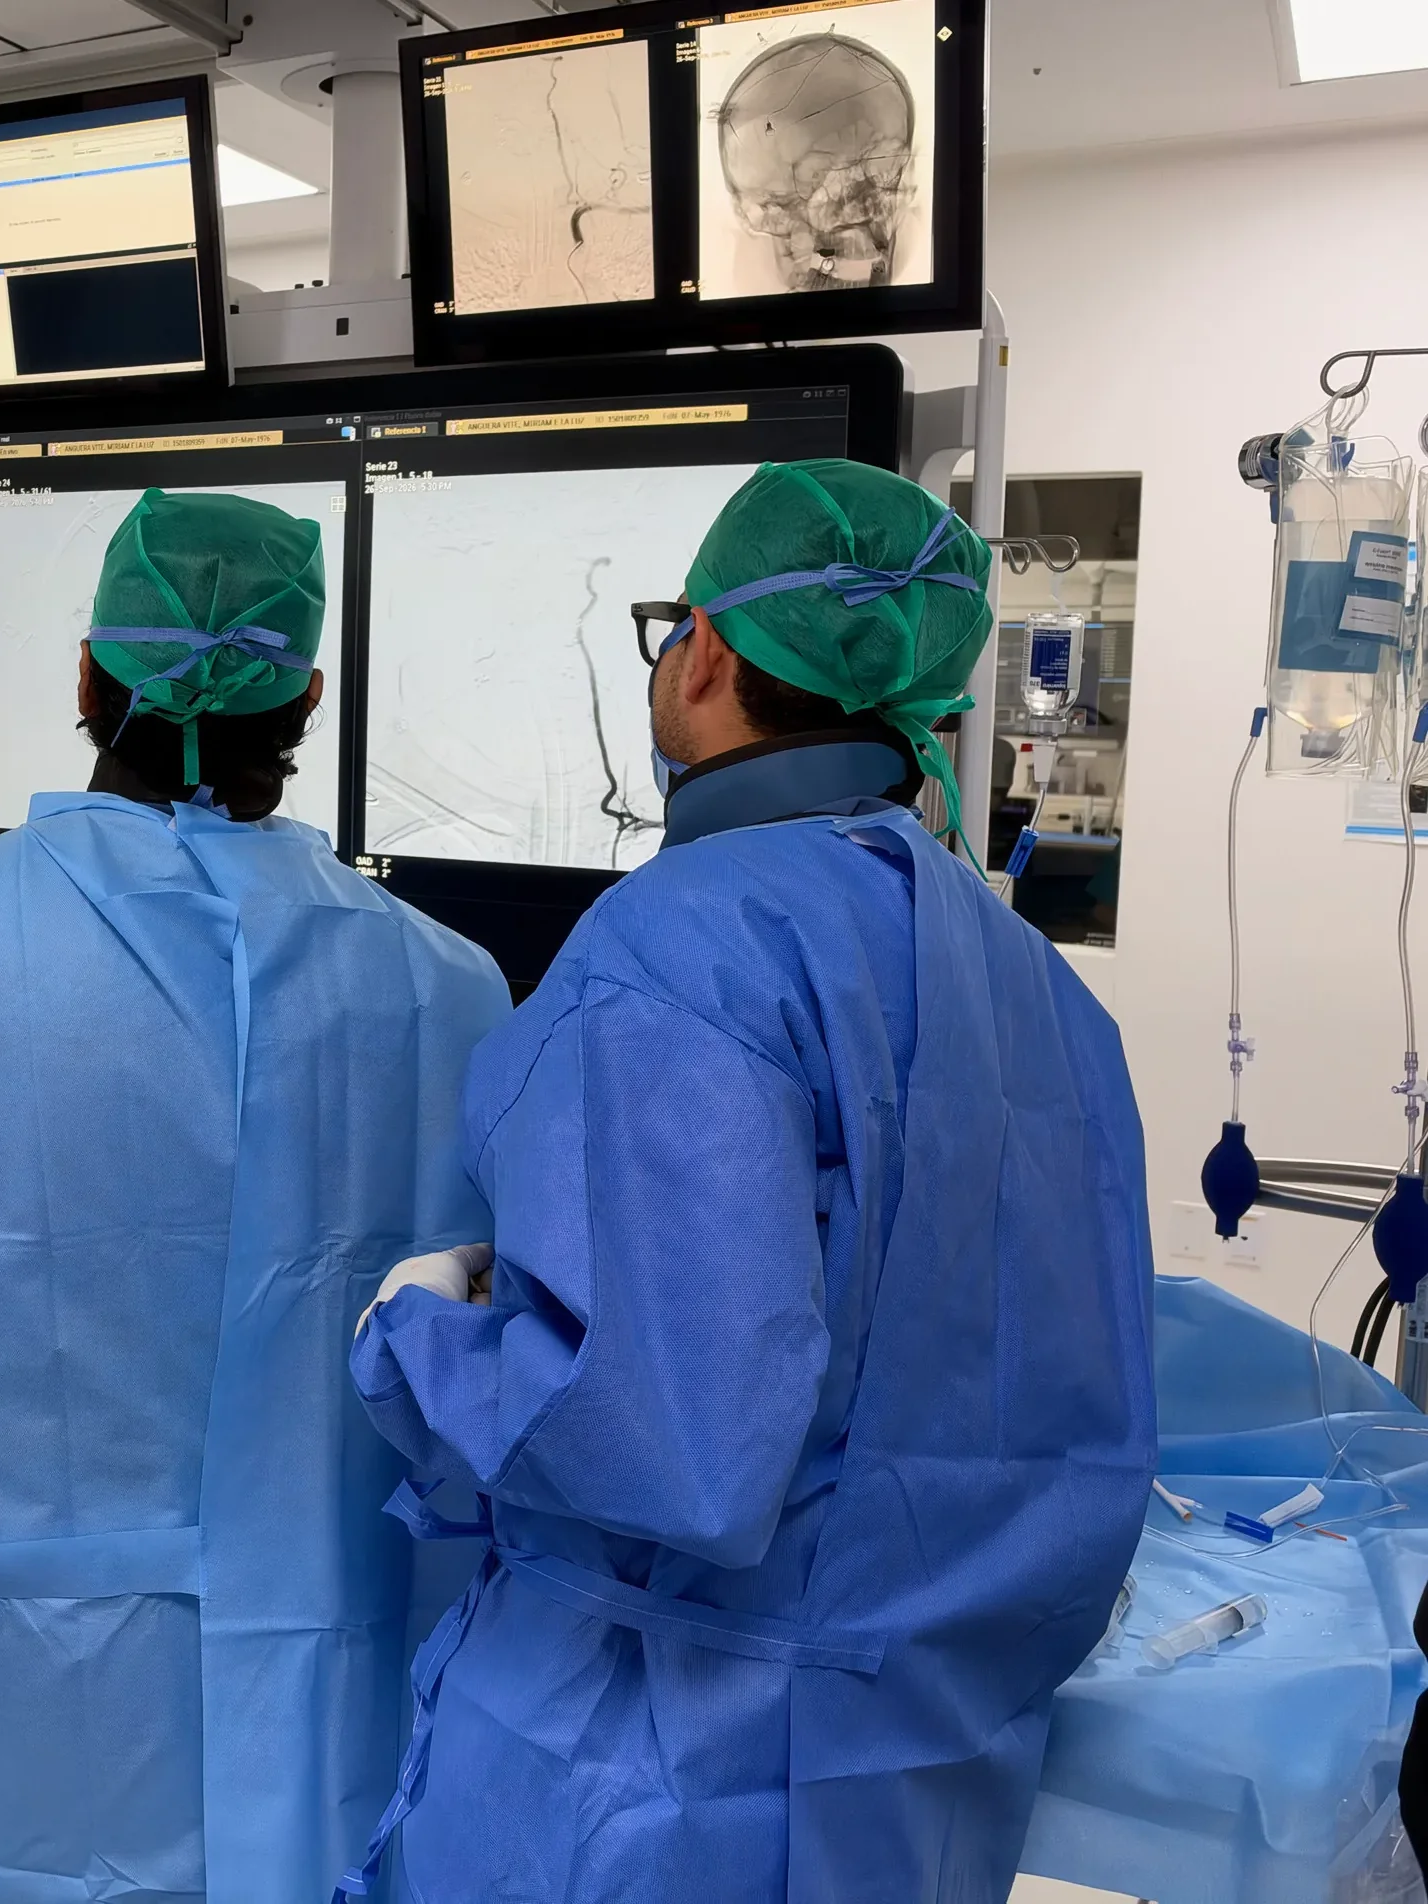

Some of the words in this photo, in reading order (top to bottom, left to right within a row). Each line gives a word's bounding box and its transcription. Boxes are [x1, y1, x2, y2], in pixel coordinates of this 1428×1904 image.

[385, 426, 421, 436] Referencia
[422, 426, 427, 434] 1
[365, 462, 387, 472] Serie
[387, 461, 398, 471] 23
[2, 478, 11, 488] 24
[365, 473, 397, 484] Imagen
[438, 481, 452, 490] PM
[356, 856, 374, 866] OAD
